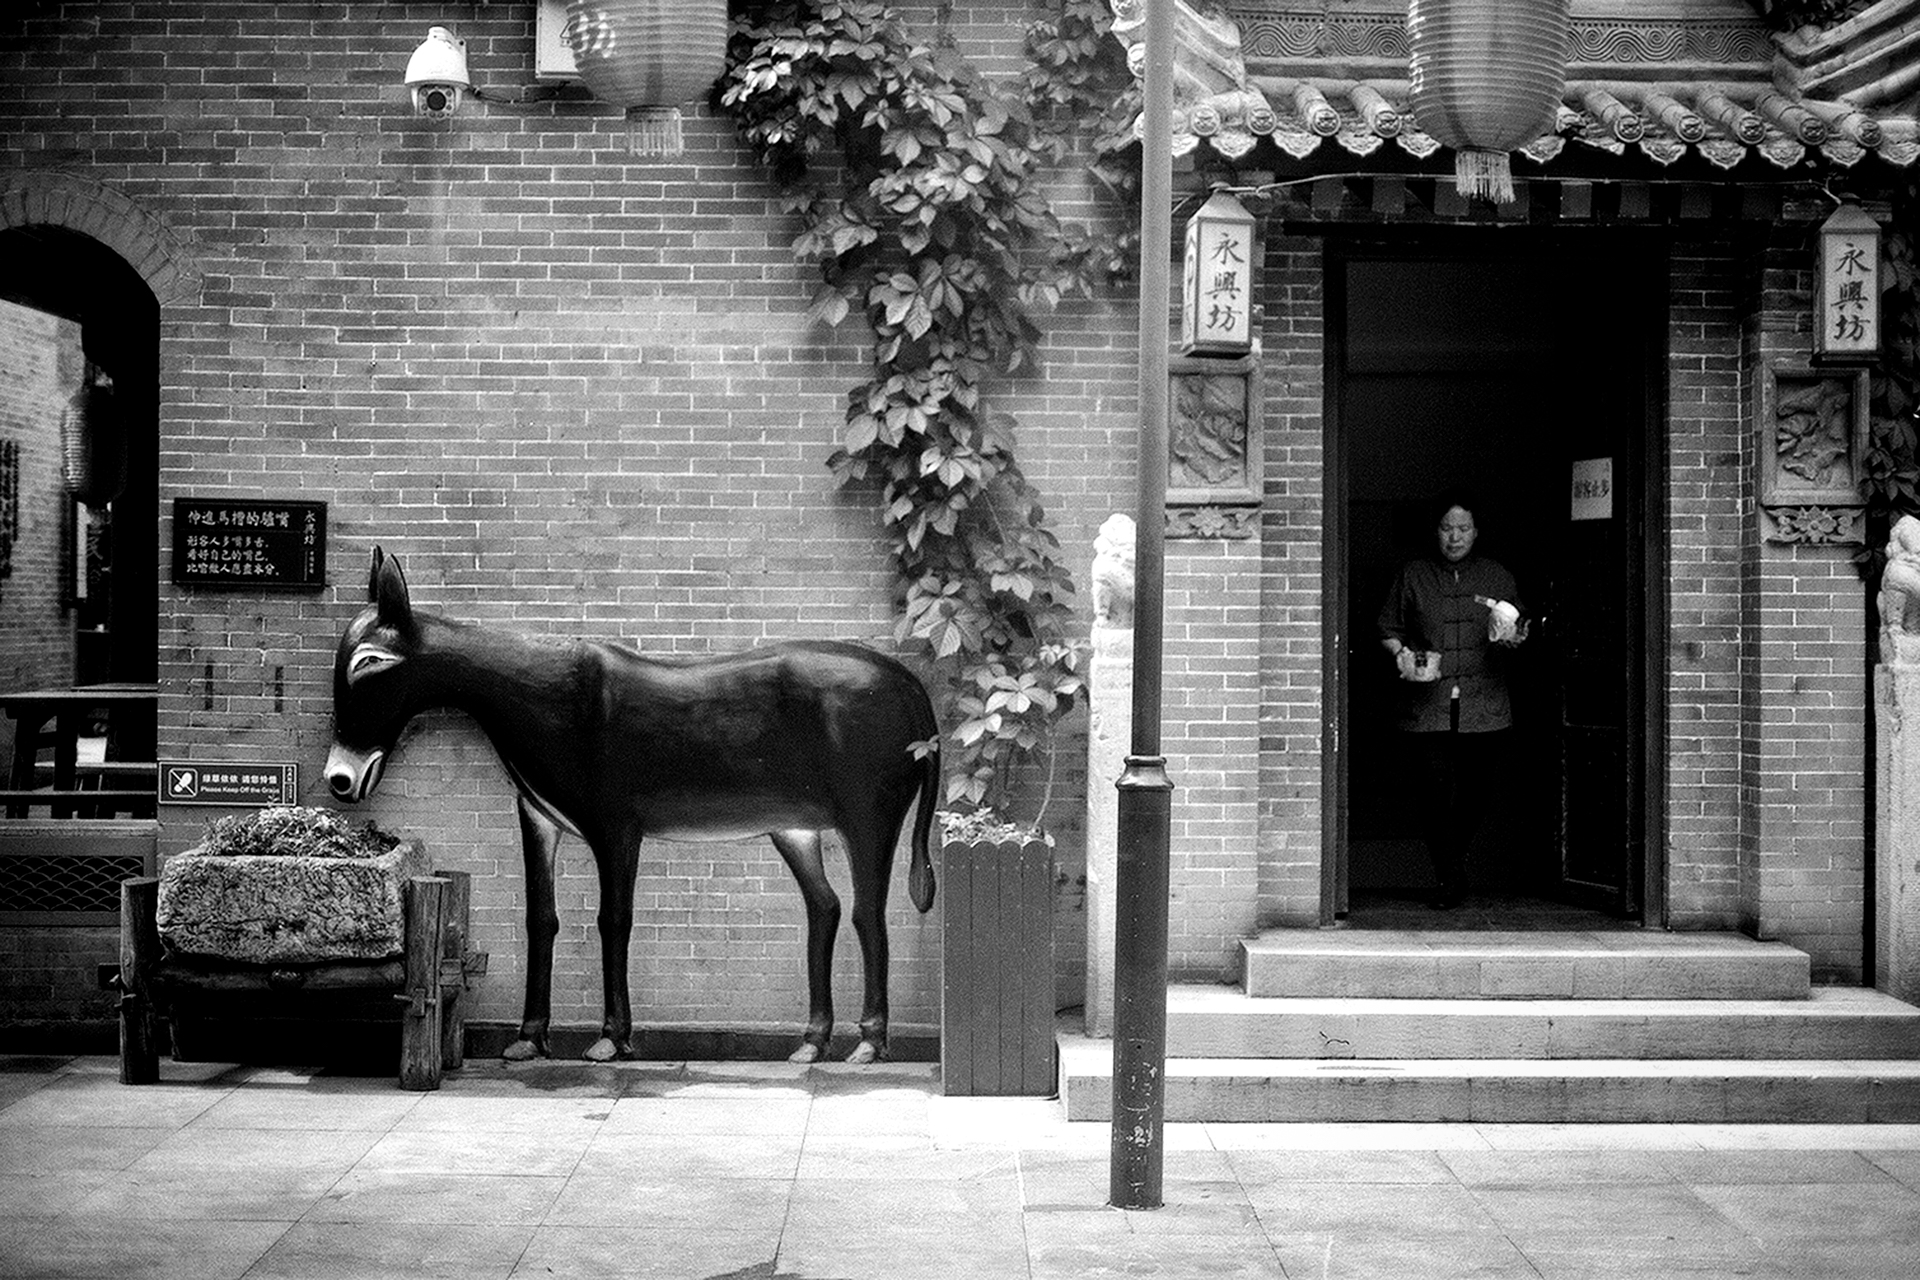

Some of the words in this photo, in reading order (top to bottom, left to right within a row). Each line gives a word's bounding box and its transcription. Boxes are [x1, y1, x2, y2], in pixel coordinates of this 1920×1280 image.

[1205, 232, 1245, 332] 永興坊
[1830, 243, 1872, 342] 永興坊
[200, 785, 221, 794] Please
[222, 786, 239, 794] Keep
[239, 786, 250, 794] Off
